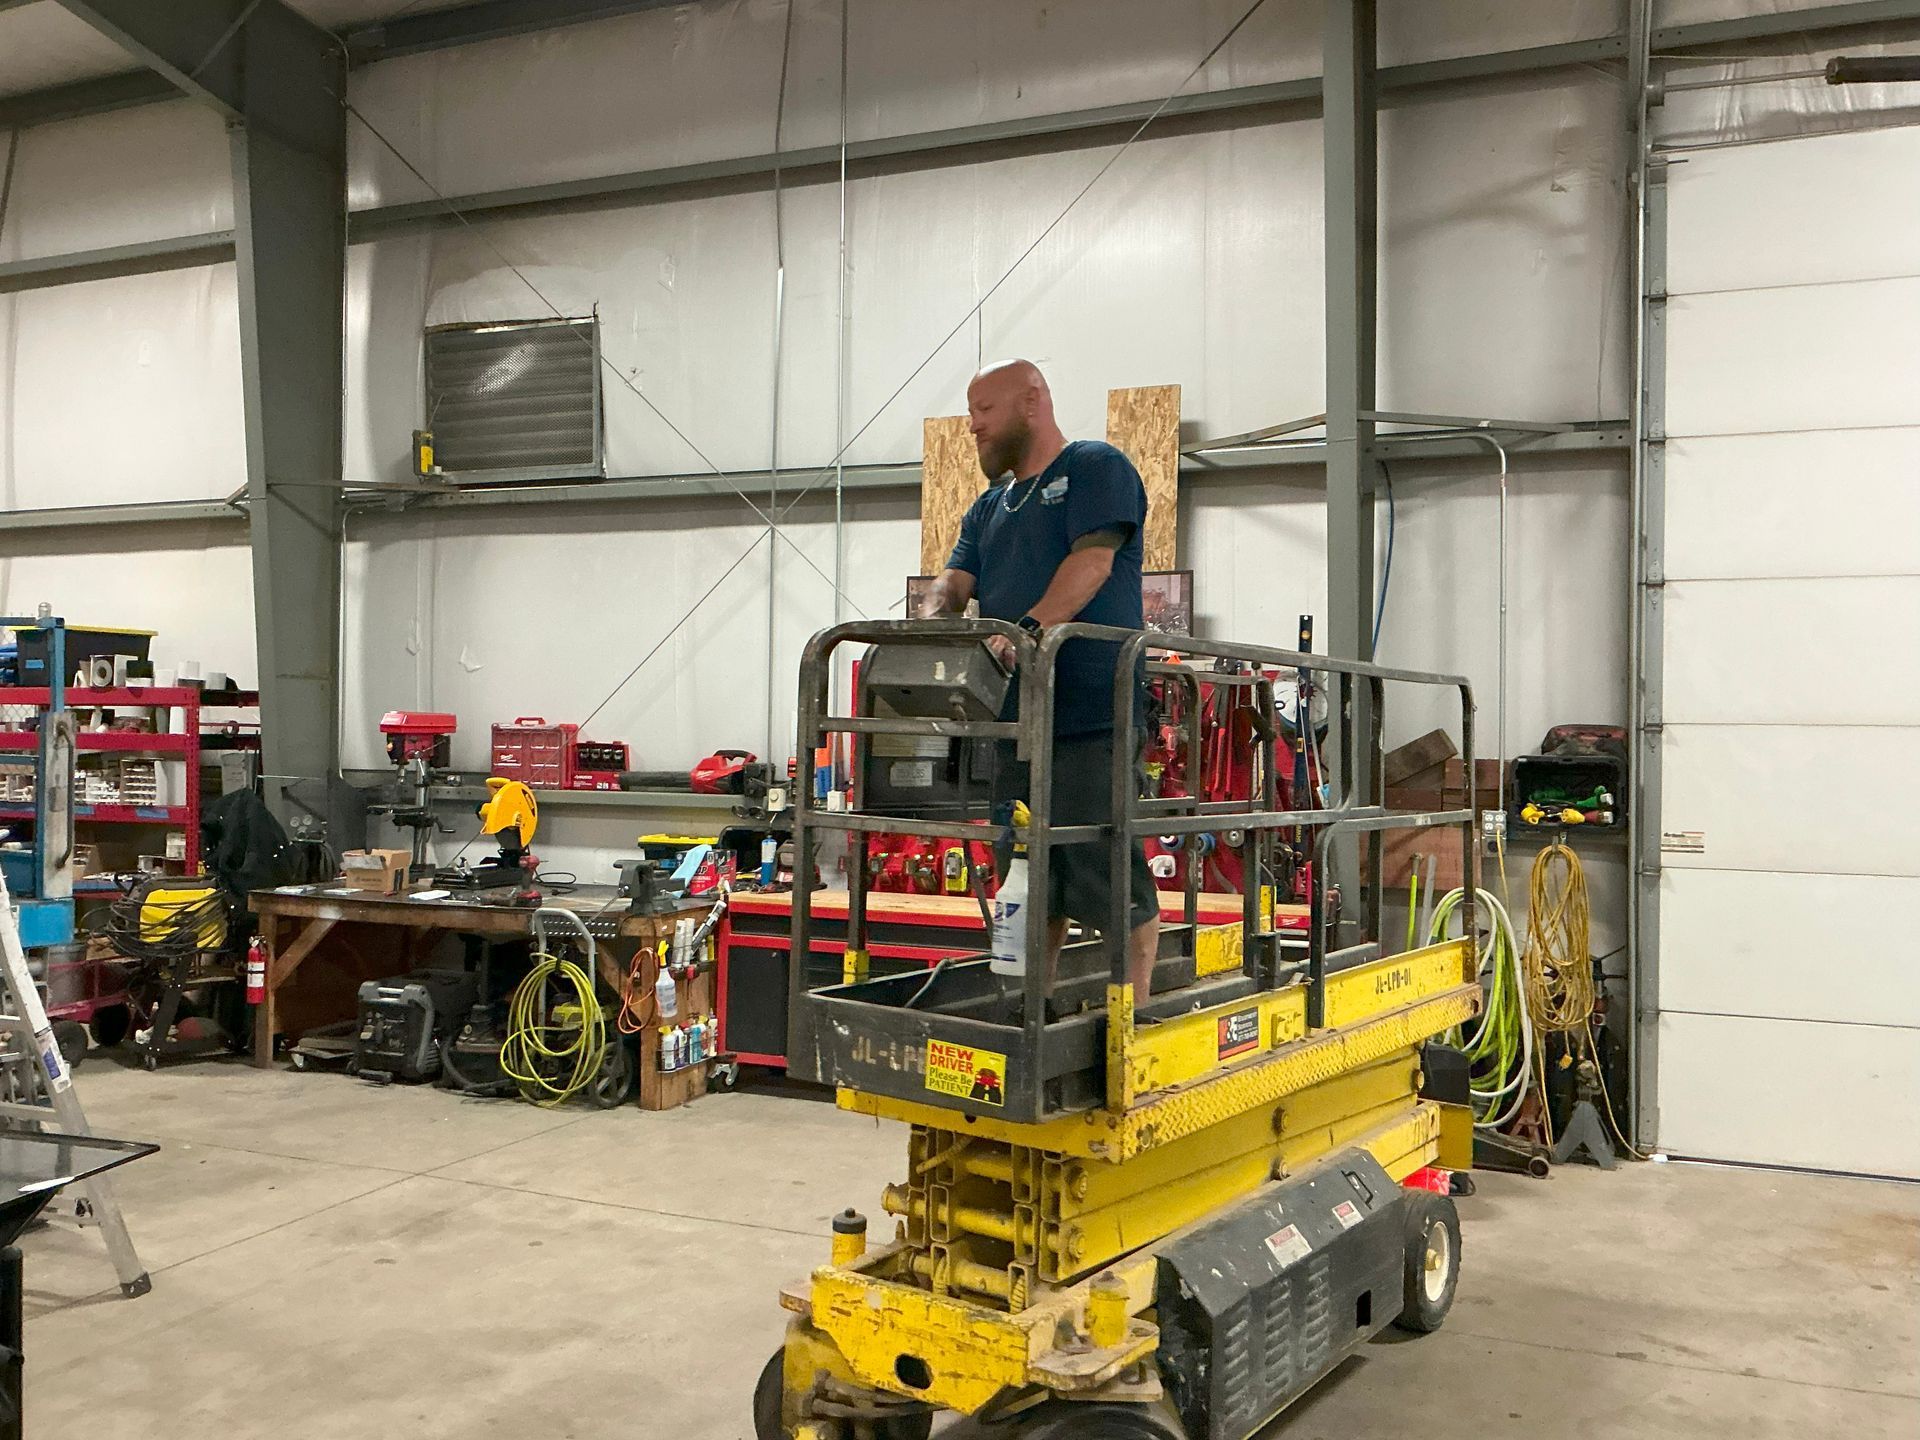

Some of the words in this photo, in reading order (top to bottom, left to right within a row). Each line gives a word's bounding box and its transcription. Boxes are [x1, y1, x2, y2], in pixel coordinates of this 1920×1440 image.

[931, 1043, 974, 1061] NEW
[930, 1053, 974, 1075] DRIVER
[929, 1067, 958, 1083] Please
[960, 1074, 973, 1087] Be
[929, 1077, 970, 1095] PATIENT
